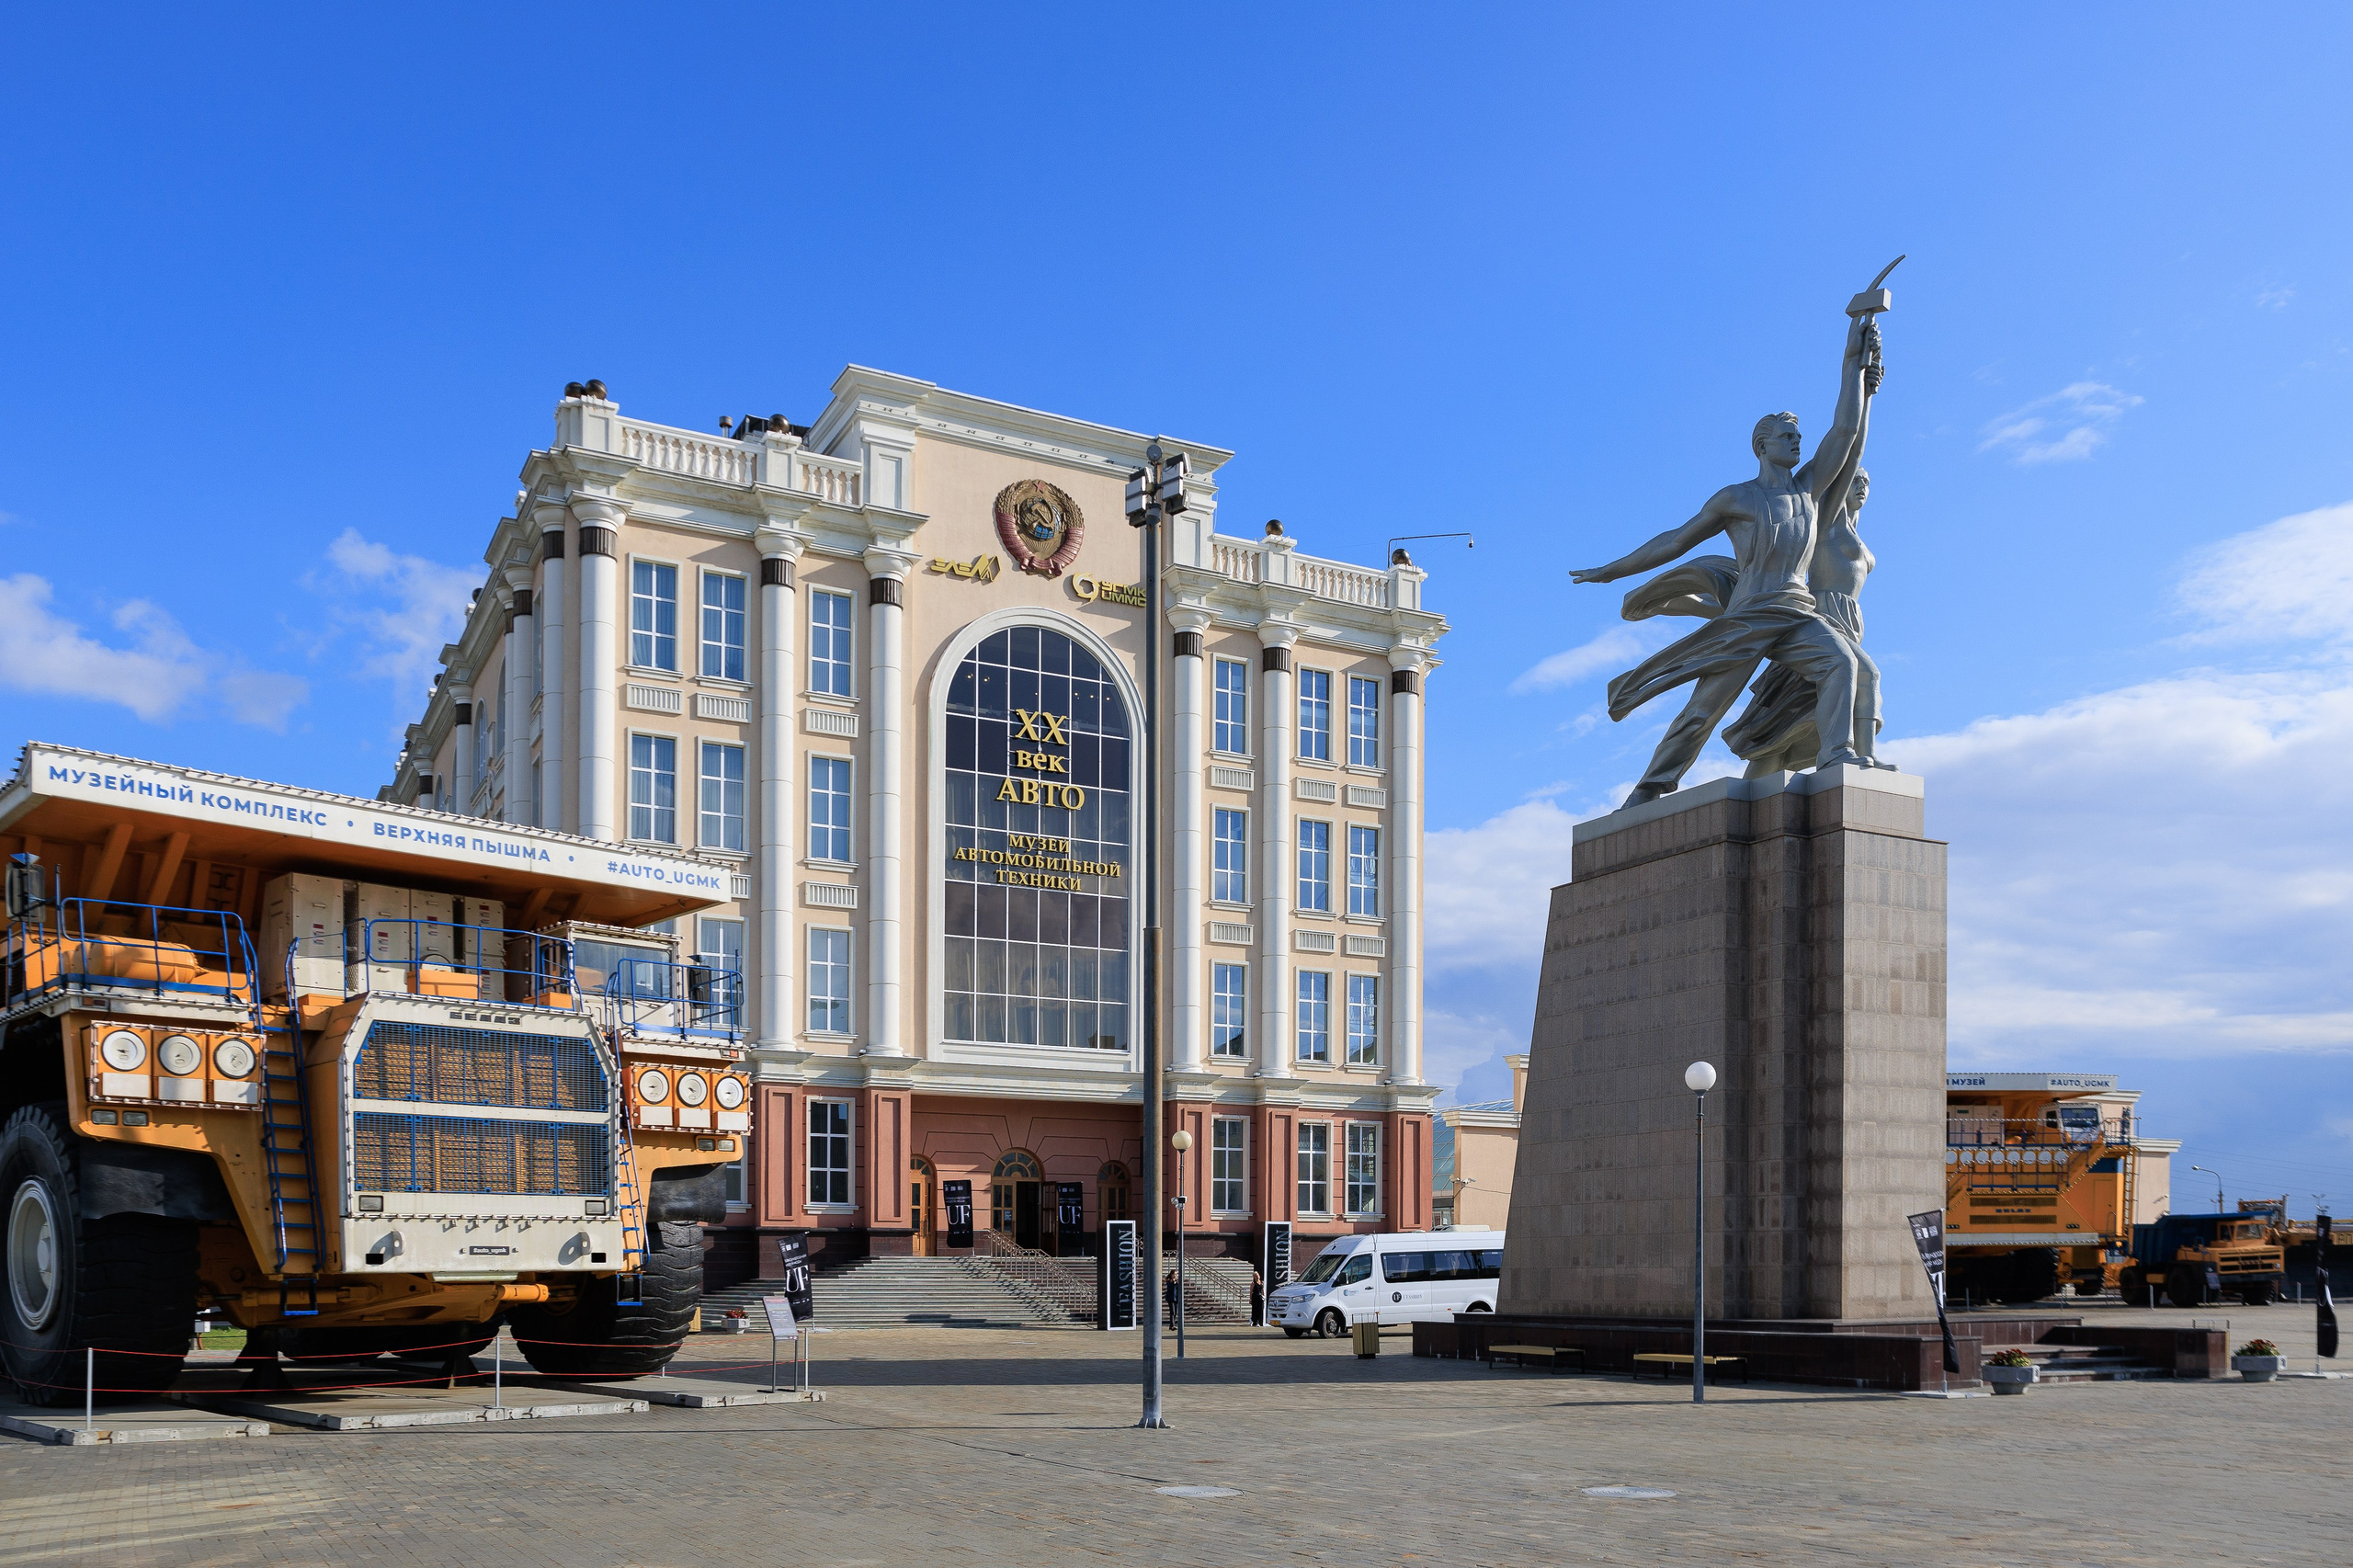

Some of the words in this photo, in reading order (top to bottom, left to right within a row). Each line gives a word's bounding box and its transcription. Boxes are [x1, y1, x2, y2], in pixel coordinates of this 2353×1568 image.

[1016, 750, 1066, 773] век
[995, 778, 1086, 810] АВТО
[49, 766, 194, 803] МУЗЕЙНЫЙ
[200, 792, 328, 826] КОМПЛЕКС
[372, 822, 466, 849] ВЕРХНЯЯ
[472, 838, 551, 862] ПЫШМА
[607, 860, 721, 890] #AUTO_UGMK
[1008, 834, 1070, 853] МУЗЕЙ
[954, 846, 1121, 877] АВТОМОБИЛЬНОЙ
[995, 869, 1082, 891] ТЕХНИКИ
[449, 1011, 520, 1025] БЕЛАЗ
[1952, 1077, 1985, 1085] МУЗЕЙ
[2051, 1078, 2110, 1087] #AUTO_UGMK
[947, 1204, 971, 1224] UF
[1059, 1205, 1082, 1224] UF
[786, 1265, 809, 1293] UF
